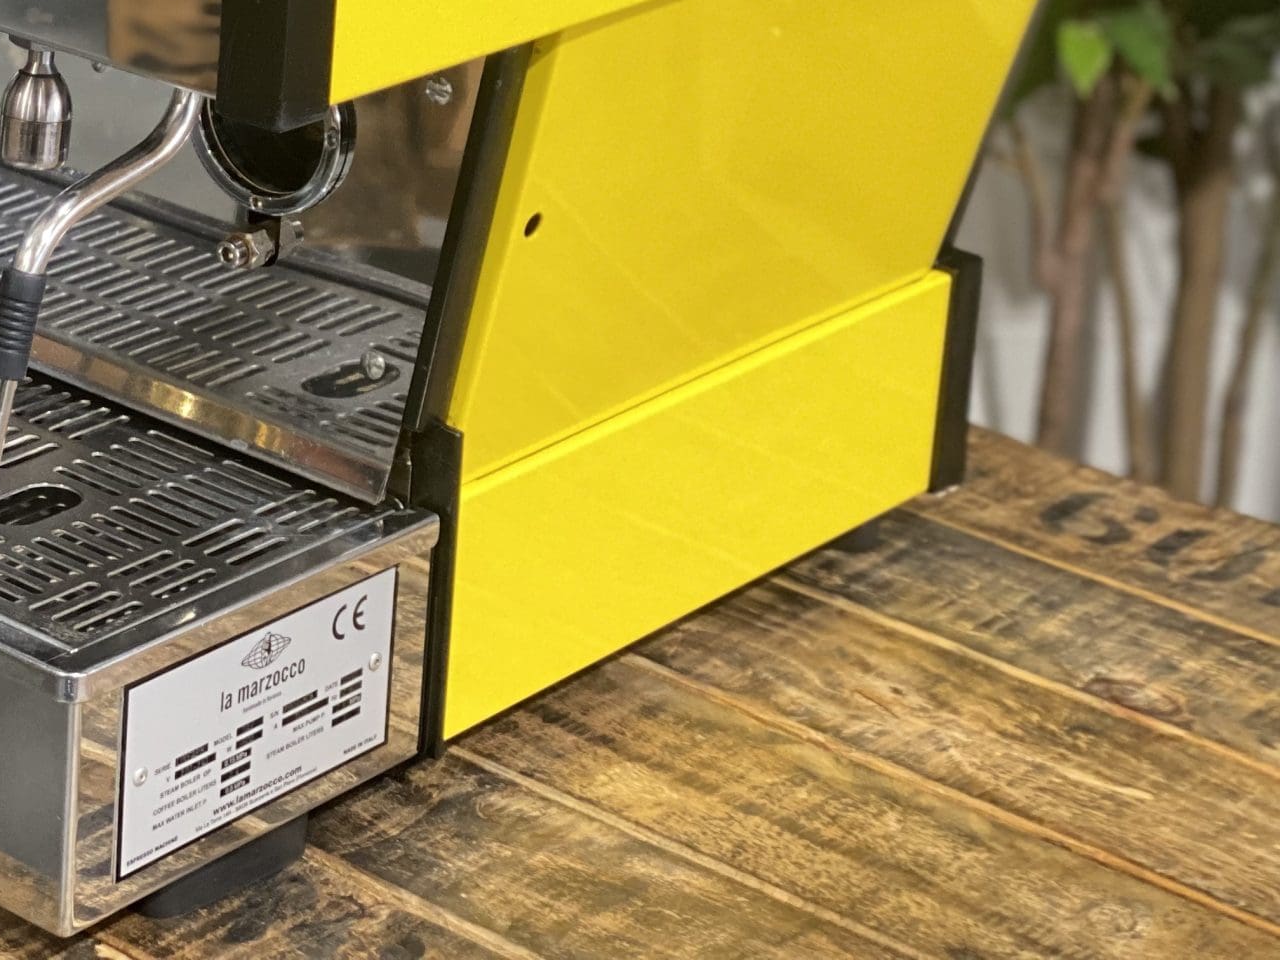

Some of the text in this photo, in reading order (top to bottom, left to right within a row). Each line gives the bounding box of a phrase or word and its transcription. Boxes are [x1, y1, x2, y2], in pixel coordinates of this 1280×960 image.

[220, 691, 232, 713] la
[237, 658, 305, 705] marzocco
[160, 785, 177, 799] STEAM
[178, 774, 200, 789] BOILER
[213, 766, 302, 815] www.lamarzocco.com
[153, 800, 175, 817] COFFEE
[176, 788, 199, 804] BOILER
[165, 809, 185, 825] WATER
